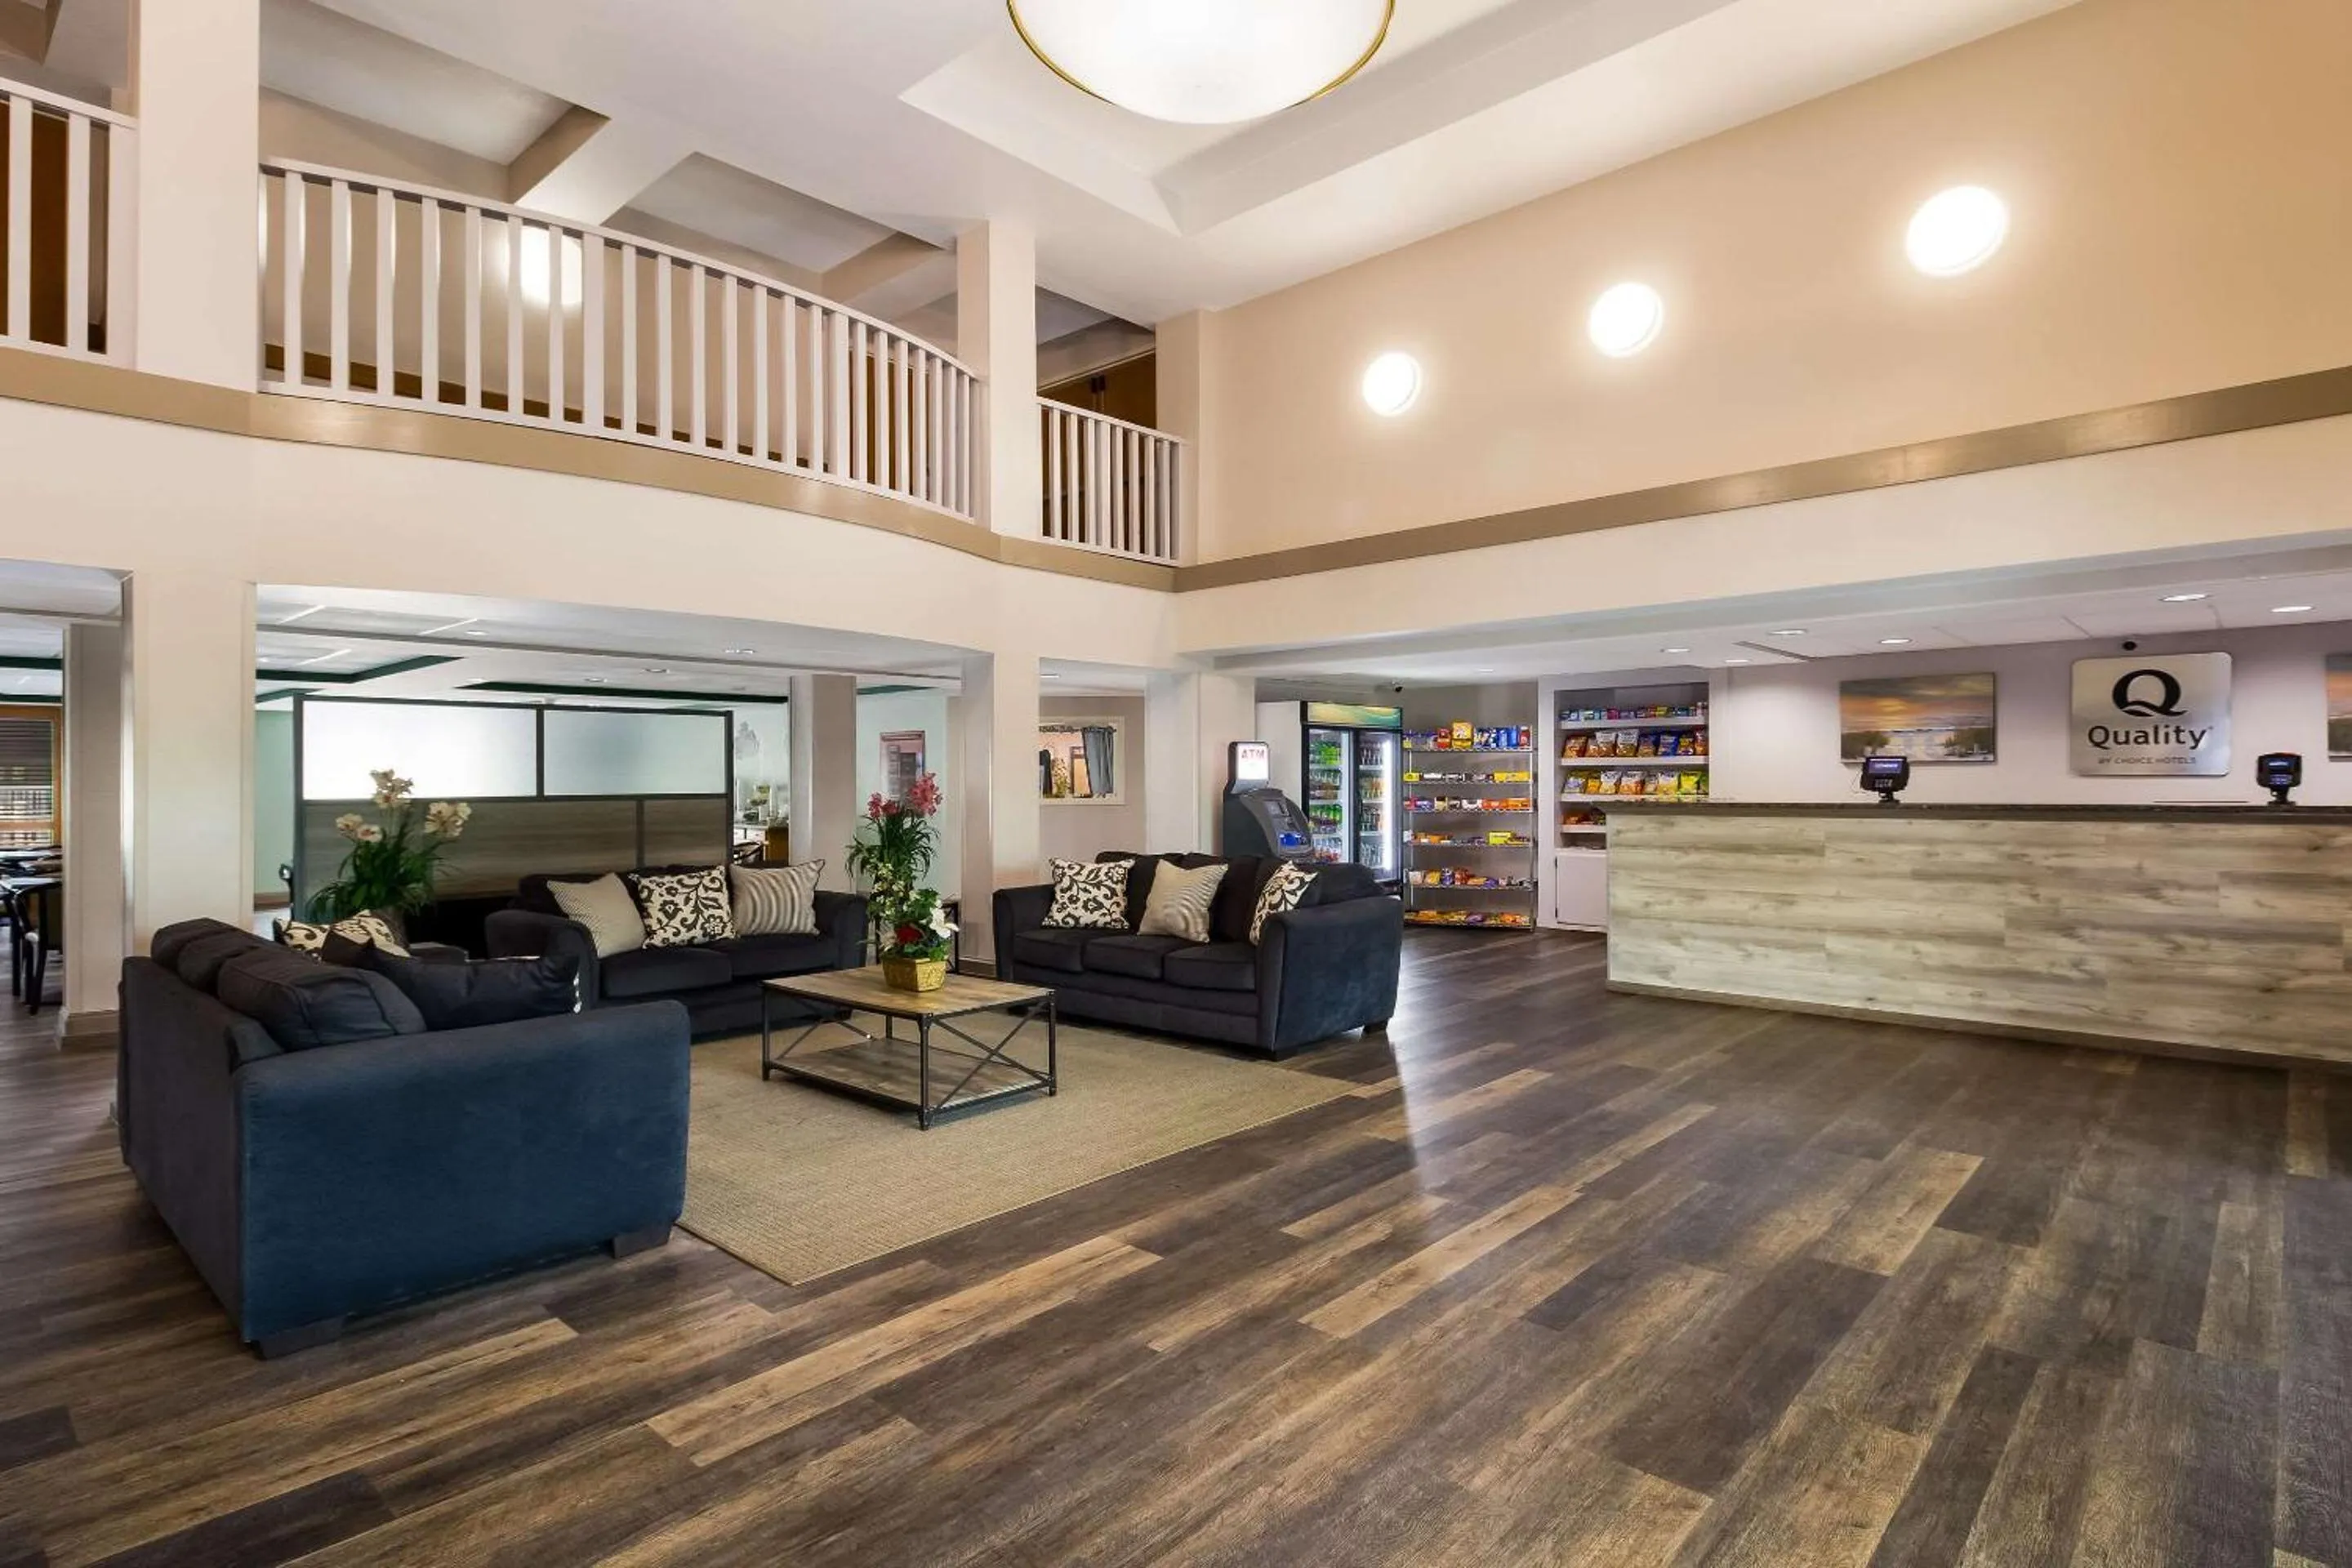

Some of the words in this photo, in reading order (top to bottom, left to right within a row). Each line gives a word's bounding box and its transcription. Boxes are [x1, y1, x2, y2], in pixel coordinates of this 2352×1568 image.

[2112, 669, 2188, 717] Q
[2087, 724, 2207, 750] Quality
[1241, 749, 1265, 759] ATM
[2097, 756, 2112, 764] BY
[2114, 756, 2154, 764] CHOICE
[2155, 756, 2196, 764] HOTELS
